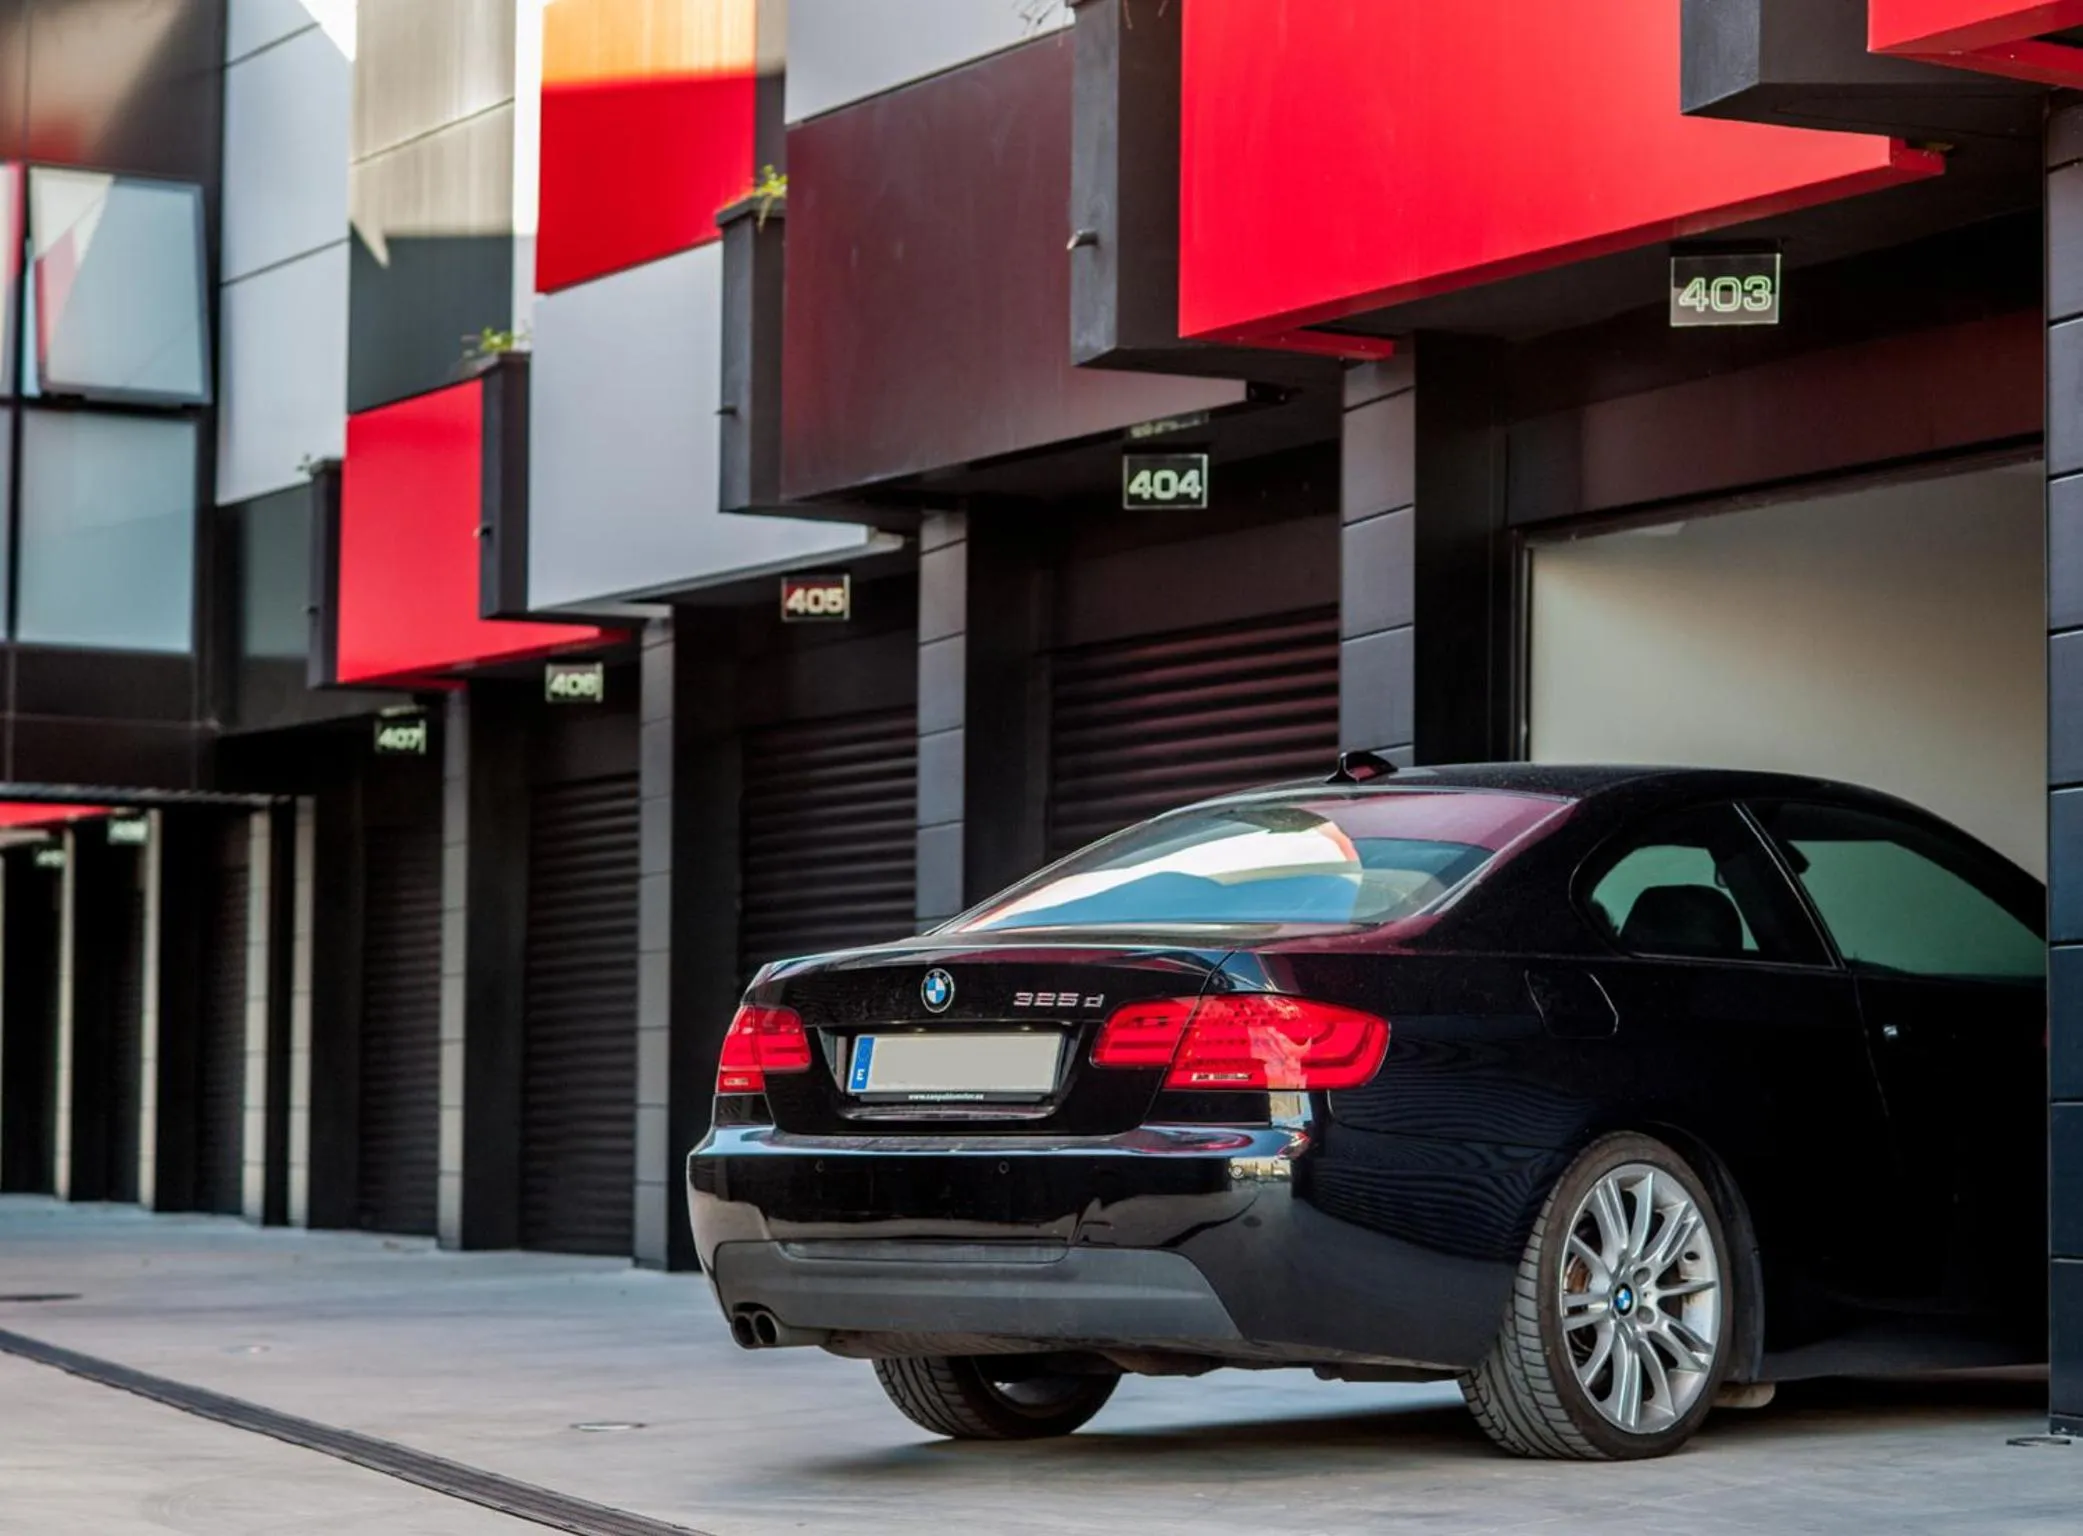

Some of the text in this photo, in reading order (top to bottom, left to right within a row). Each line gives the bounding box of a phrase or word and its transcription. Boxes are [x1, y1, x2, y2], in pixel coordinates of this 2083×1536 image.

[1678, 275, 1772, 312] 403
[1128, 469, 1202, 499] 404
[786, 587, 844, 614] 405
